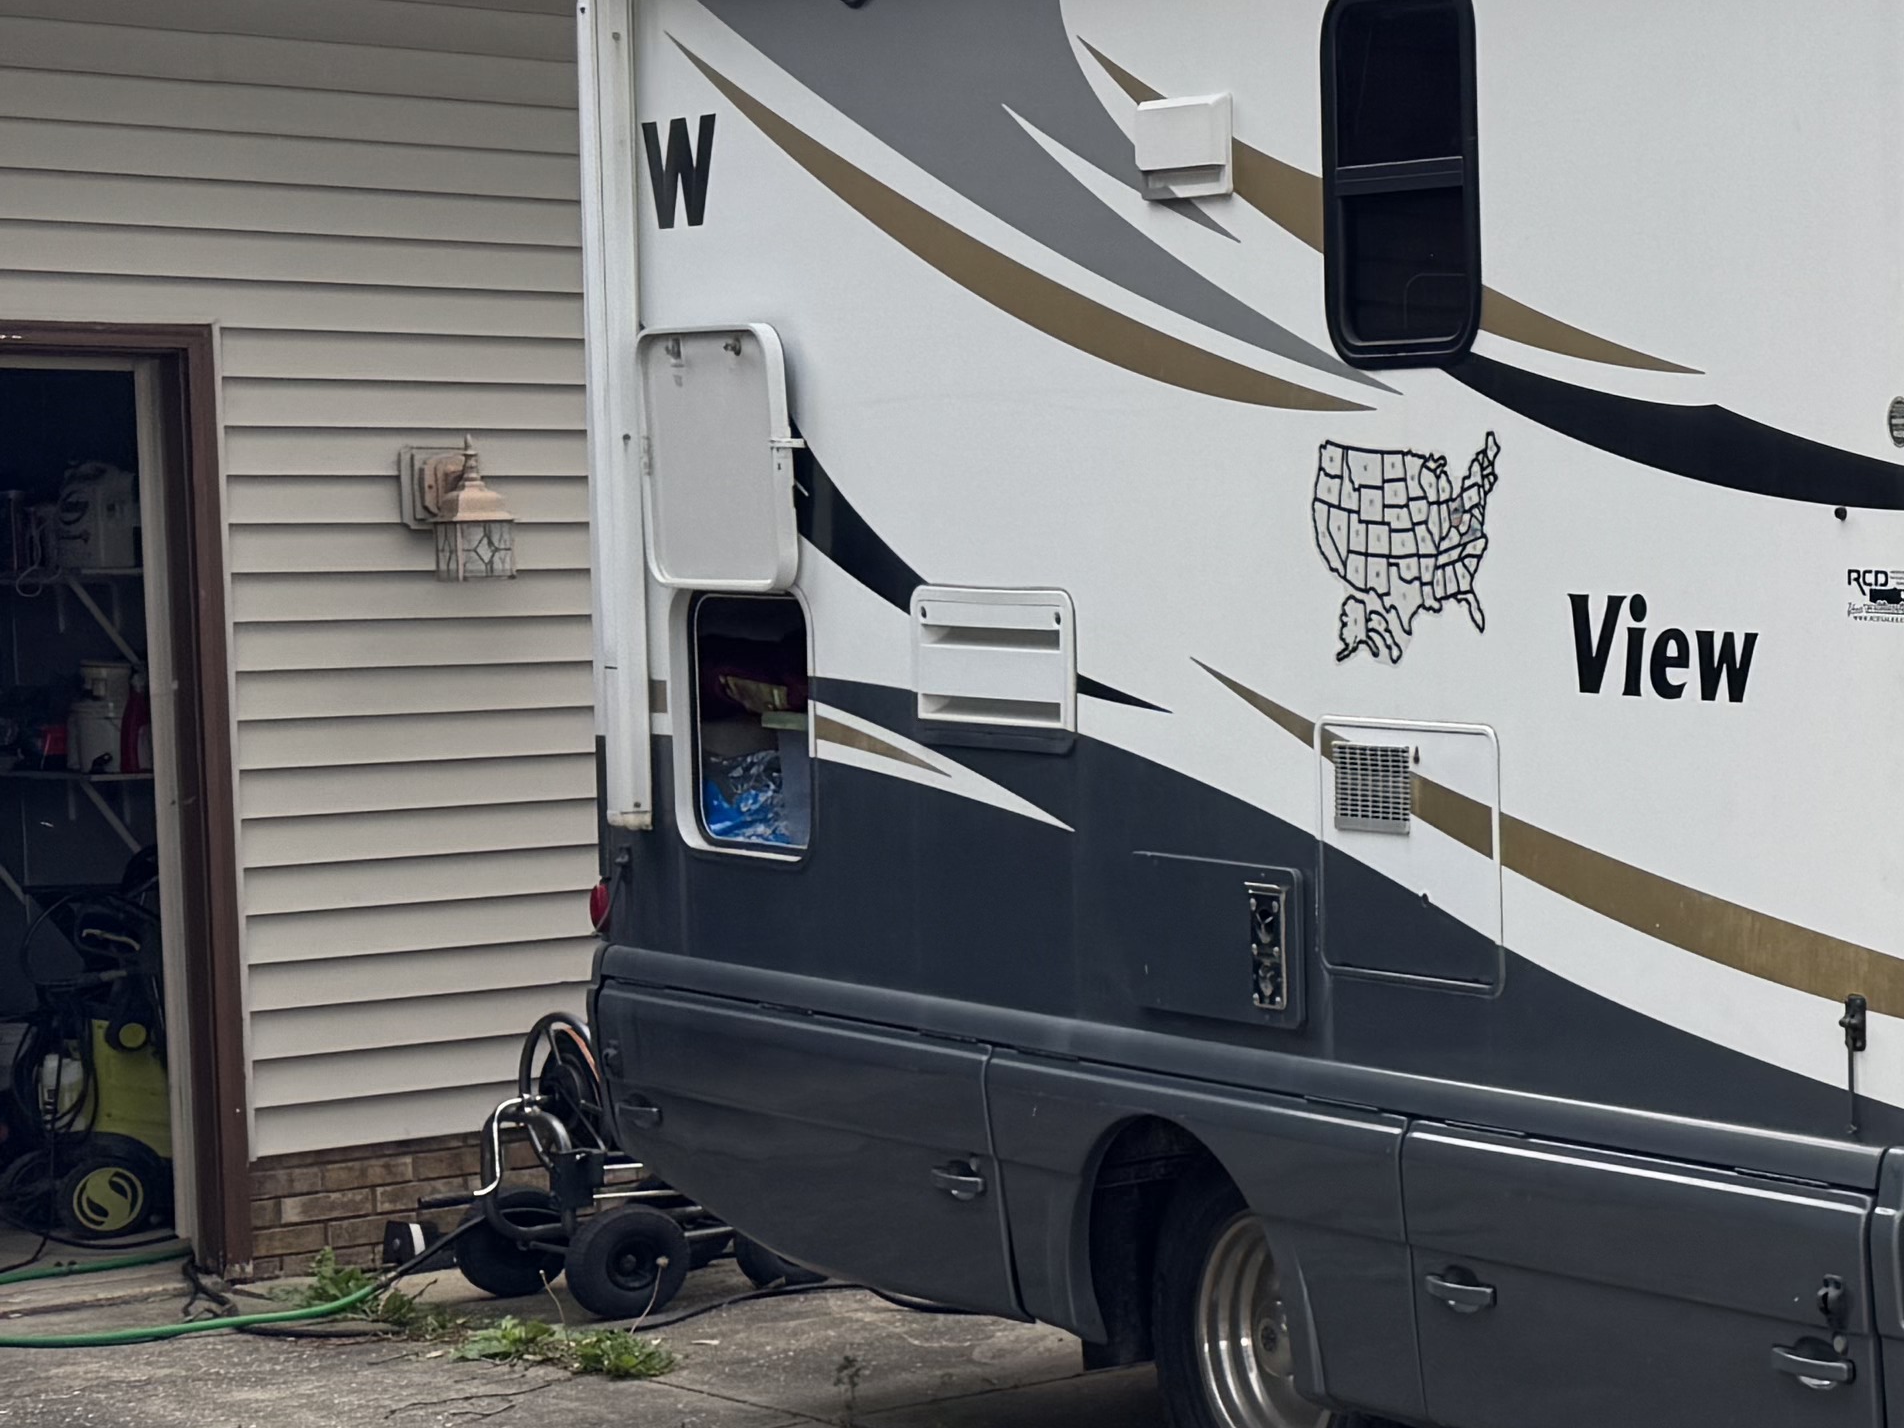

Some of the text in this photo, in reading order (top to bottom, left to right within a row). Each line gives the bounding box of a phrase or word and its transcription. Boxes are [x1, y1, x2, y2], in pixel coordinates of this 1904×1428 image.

[642, 114, 716, 229] W
[1847, 569, 1889, 596] RCD
[1567, 594, 1758, 703] View
